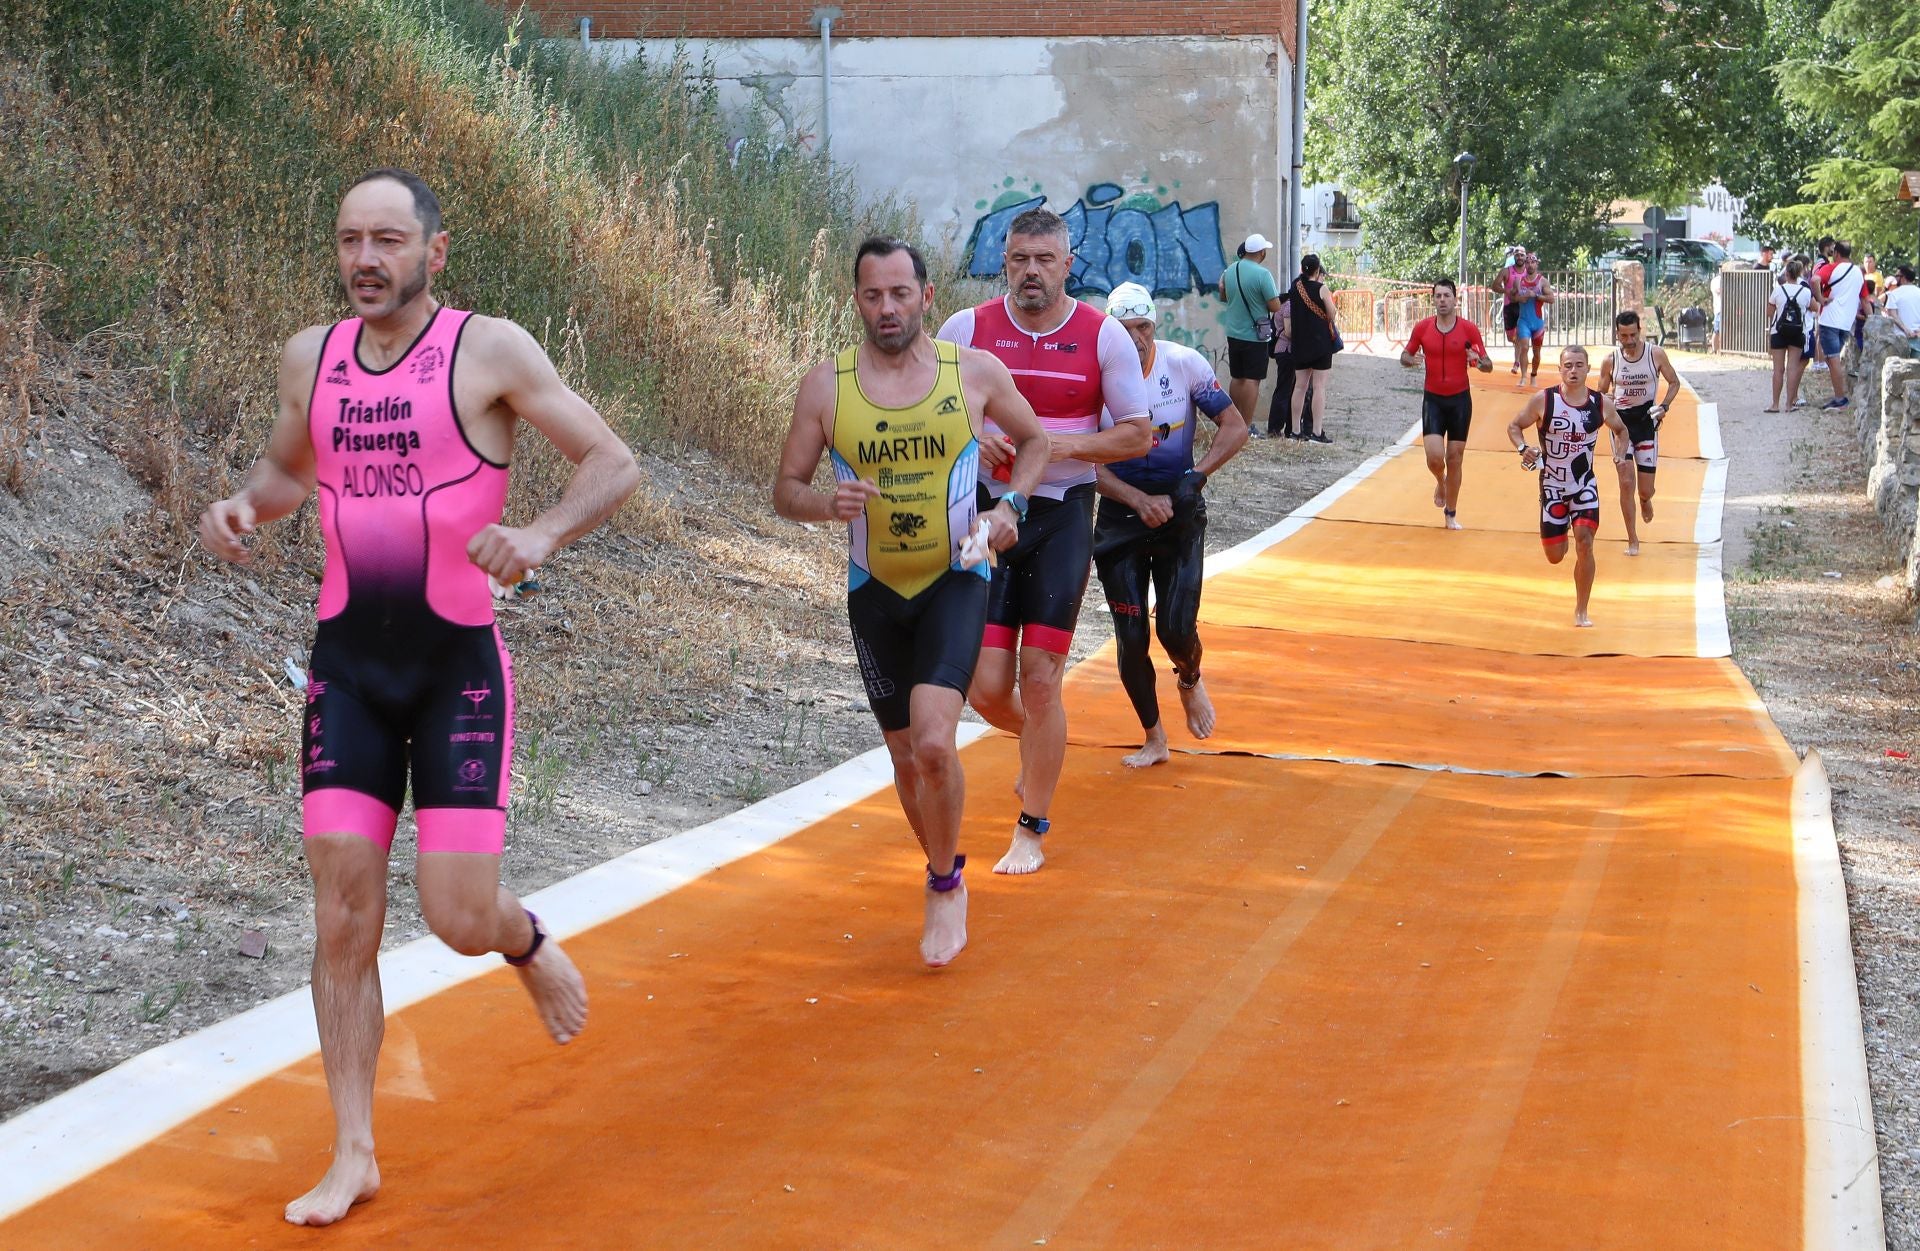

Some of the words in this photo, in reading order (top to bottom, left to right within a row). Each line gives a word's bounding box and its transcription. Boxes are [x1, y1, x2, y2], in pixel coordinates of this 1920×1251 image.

[995, 340, 1019, 349] GOBIK
[1623, 388, 1647, 397] ALBERTO
[338, 396, 412, 424] Triatlón
[332, 426, 421, 457] Pisuerga
[858, 434, 946, 465] MARTIN
[342, 463, 424, 498] ALONSO
